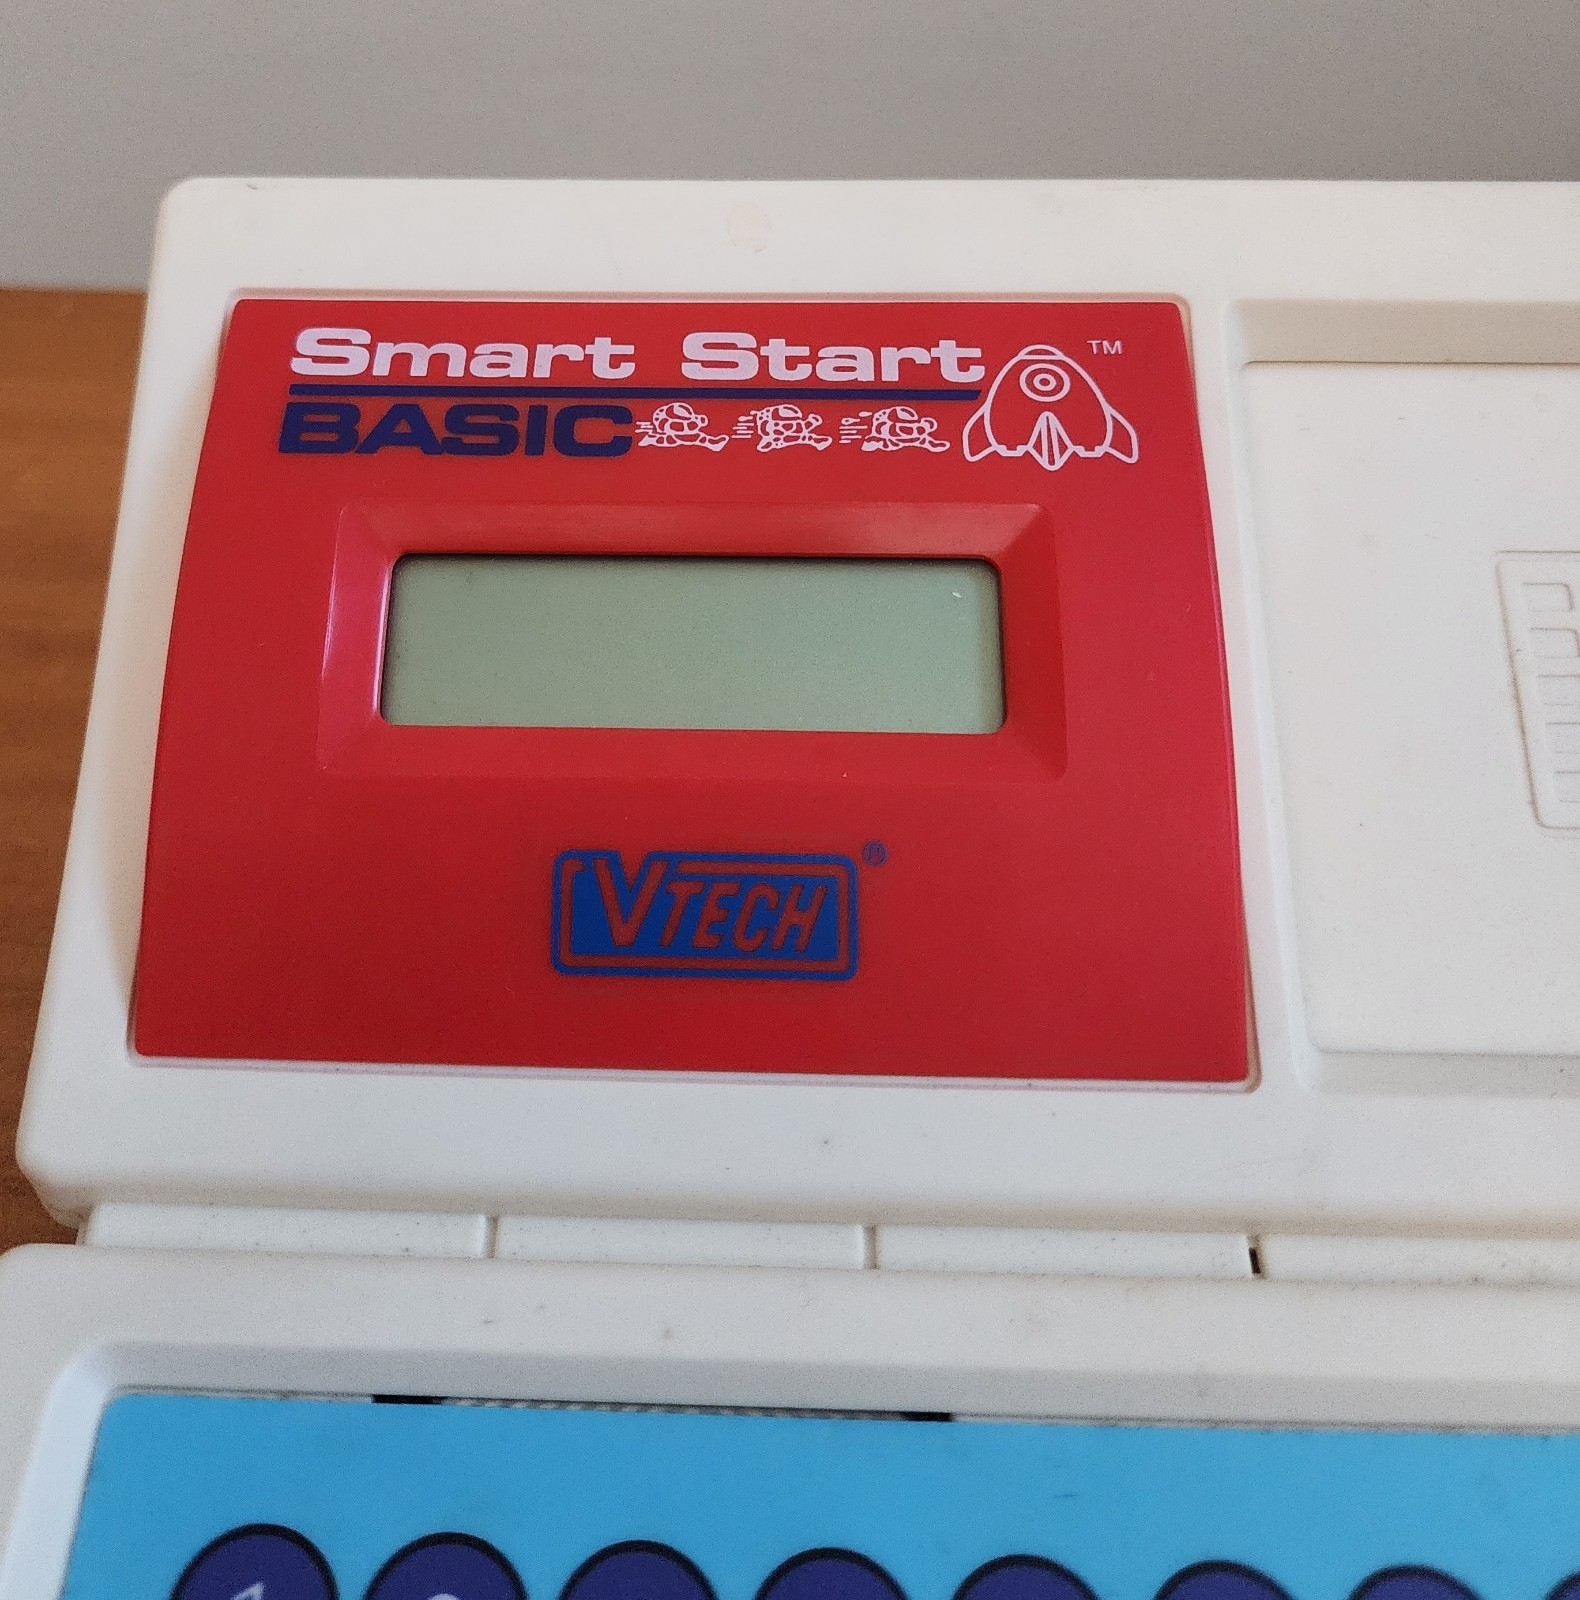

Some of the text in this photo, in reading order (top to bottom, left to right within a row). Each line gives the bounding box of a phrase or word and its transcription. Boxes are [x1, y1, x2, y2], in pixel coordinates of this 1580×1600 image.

[290, 327, 986, 384] Smart Start
[278, 401, 633, 458] BASIC
